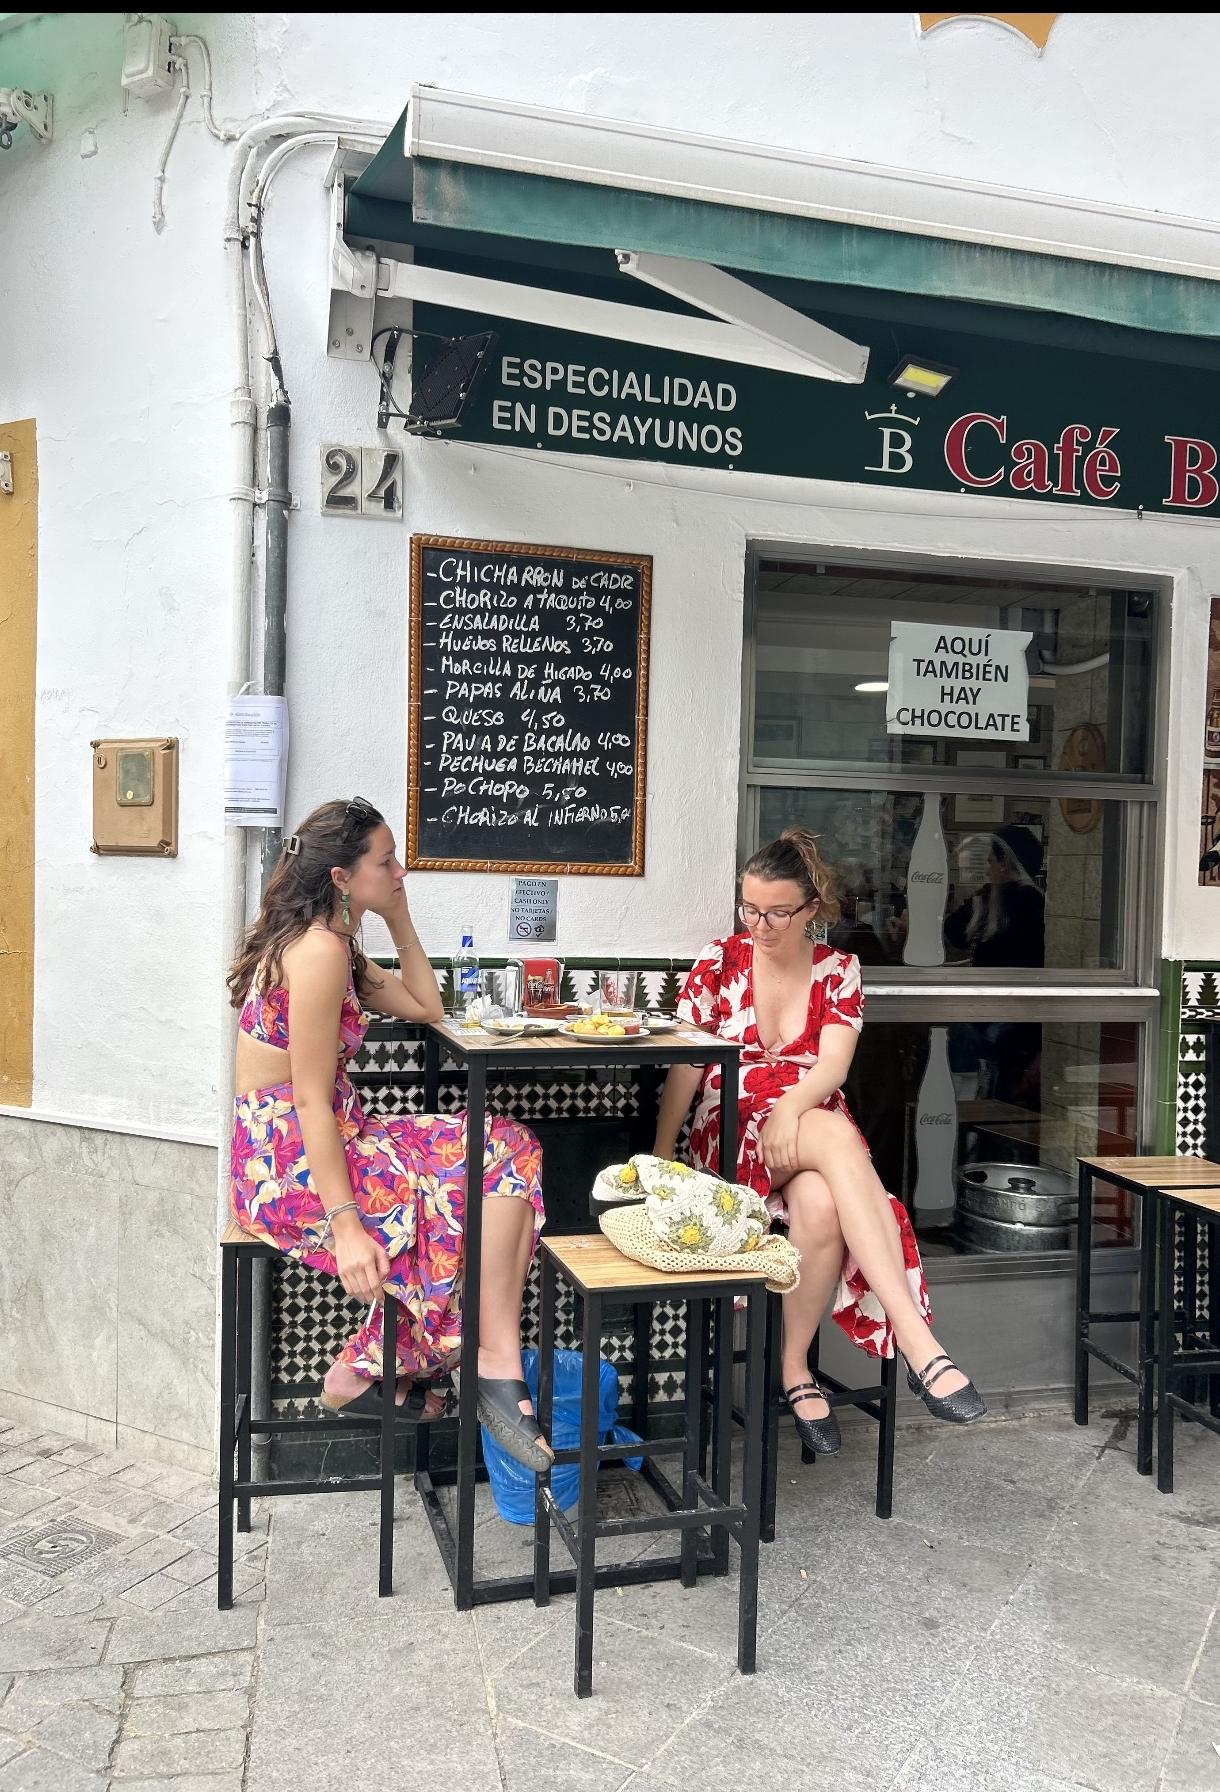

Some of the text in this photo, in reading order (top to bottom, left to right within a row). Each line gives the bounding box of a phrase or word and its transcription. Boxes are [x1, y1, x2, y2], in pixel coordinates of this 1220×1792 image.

[502, 356, 737, 412] ESPECIALIDAD
[492, 400, 743, 456] EN DESAYUNOS
[864, 427, 914, 474] B
[944, 412, 1121, 500] Café
[324, 448, 400, 511] 24
[439, 558, 564, 588] CHICHARRON
[439, 586, 518, 610] CHORIZO
[600, 595, 633, 614] 4,00
[439, 612, 604, 632] ENSALADILLA 3,70
[439, 631, 614, 655] HUEVOS RELLENOS 3,70
[934, 633, 991, 658] AQUÍ
[441, 656, 633, 684] MORCILLA DE HIGADO 4,00
[912, 658, 1009, 683] TAMBIÉN
[445, 679, 611, 703] PAPAS ALIÑA 3,70
[939, 685, 982, 706] HAY
[442, 705, 565, 732] QUESO 4,50
[895, 707, 1021, 733] CHOCOLATE
[497, 734, 519, 752] DE
[523, 728, 591, 753] BACALAO
[597, 732, 631, 751] 4,00
[439, 753, 518, 774] PECHUGA
[606, 761, 633, 779] 4,00
[541, 783, 588, 802] 5,50
[523, 803, 540, 827] AL
[548, 803, 608, 827] INFIERNO
[911, 871, 945, 884] Coca-Cola
[919, 1113, 953, 1126] Coca-Cola
